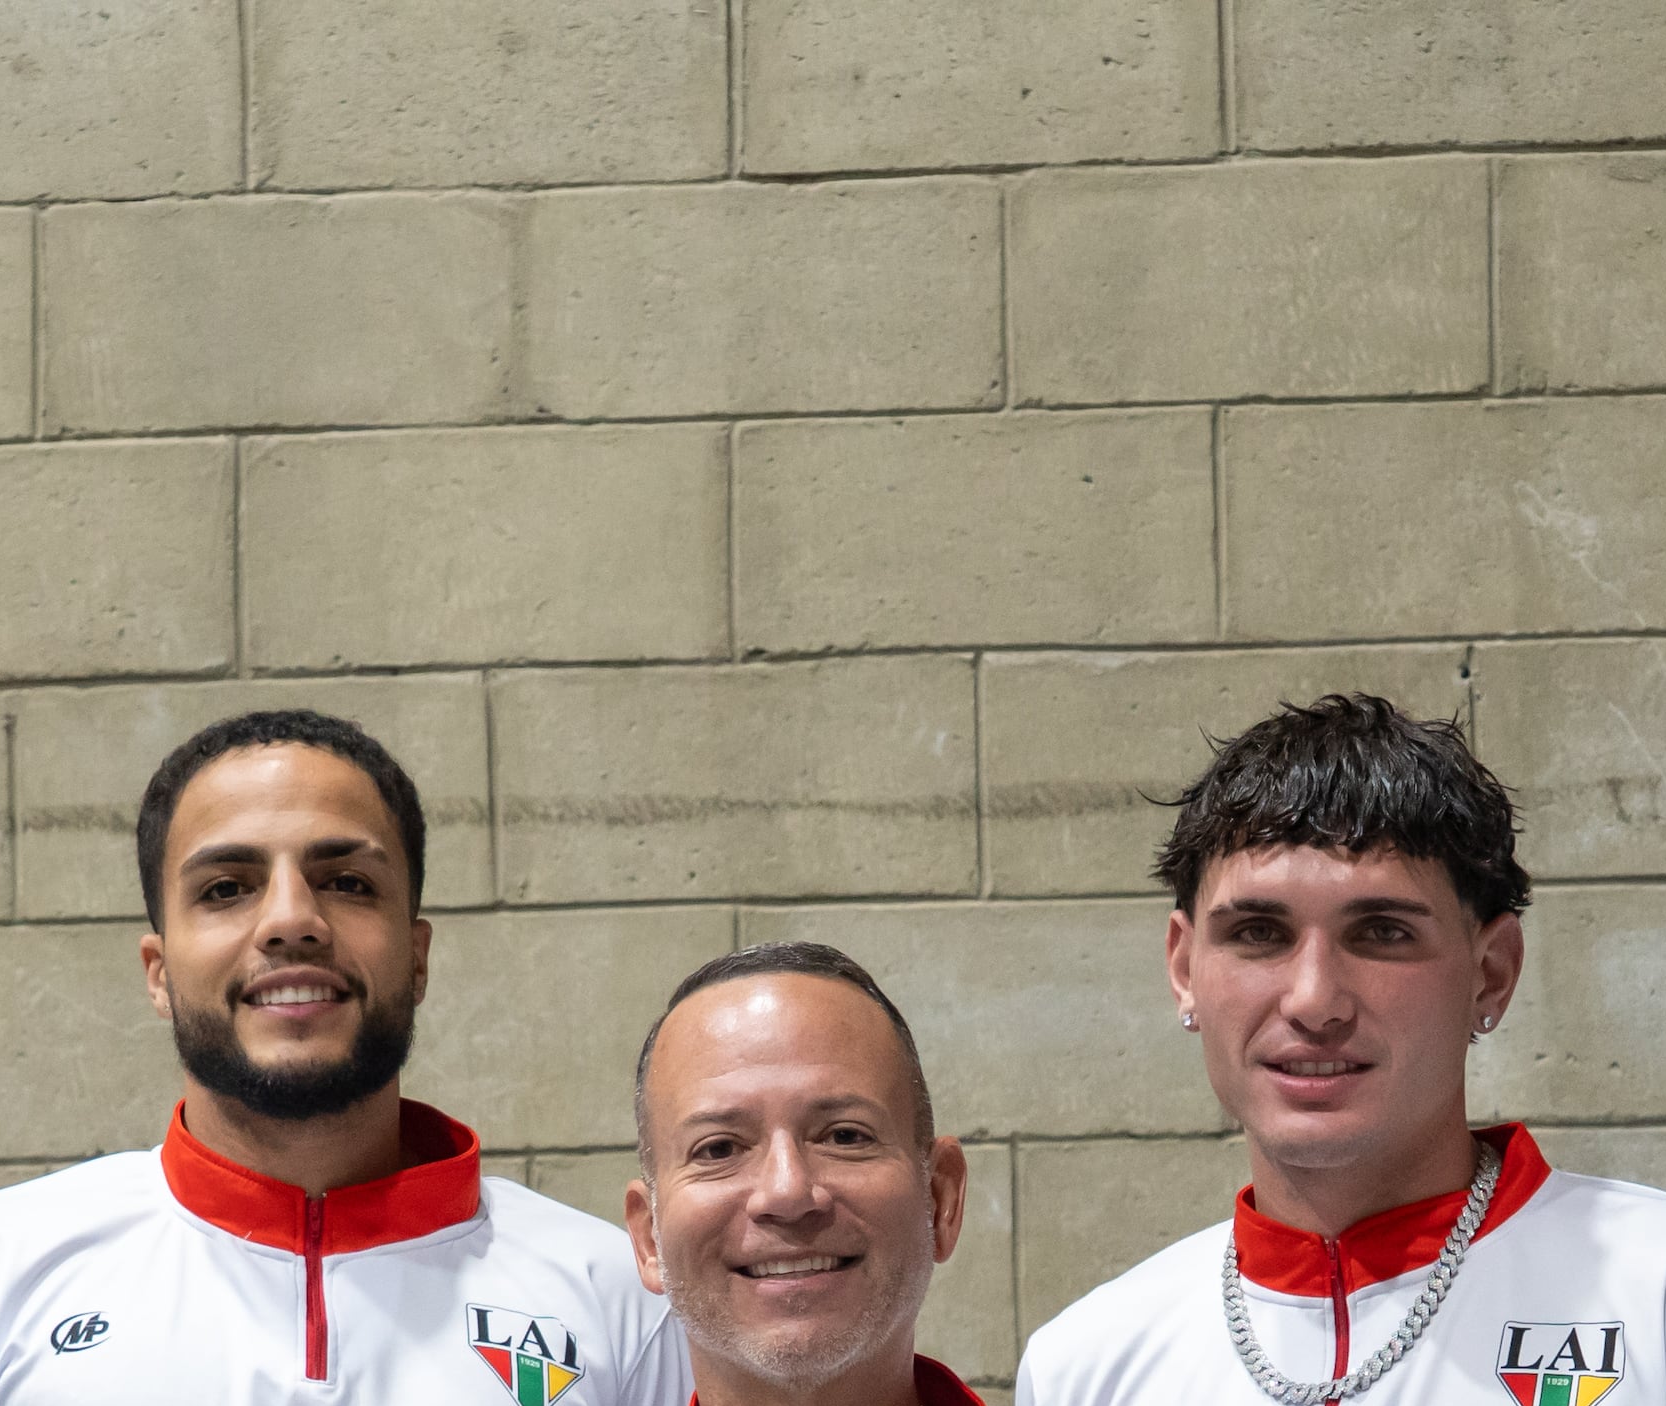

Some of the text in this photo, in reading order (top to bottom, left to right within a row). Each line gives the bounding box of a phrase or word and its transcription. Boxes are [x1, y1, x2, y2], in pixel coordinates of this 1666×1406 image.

[1500, 1326, 1621, 1373] LAI
[520, 1357, 541, 1369] 1929
[1546, 1377, 1570, 1386] 1929
